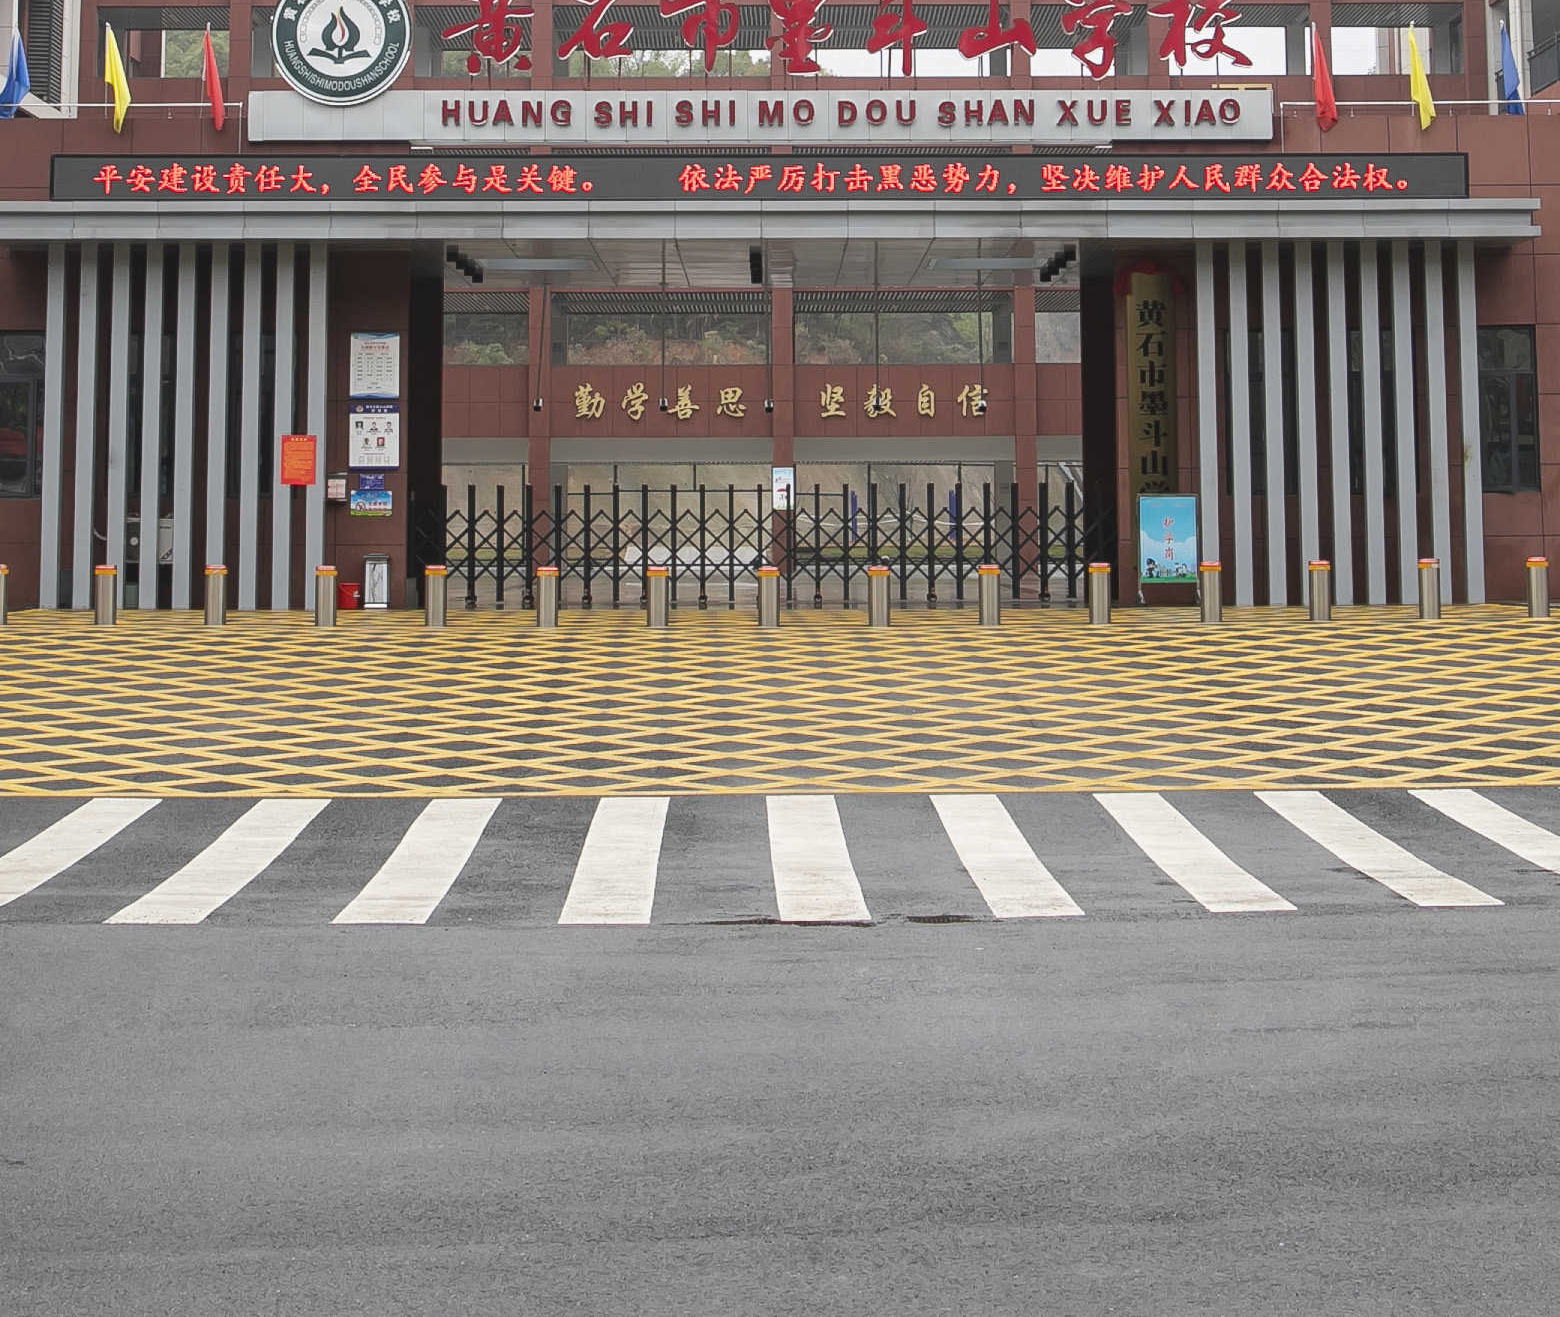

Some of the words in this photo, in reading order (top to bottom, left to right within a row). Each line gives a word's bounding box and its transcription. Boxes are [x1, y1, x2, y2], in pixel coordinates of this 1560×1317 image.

[441, 99, 571, 126] HUANG
[594, 100, 653, 126] SHI
[675, 99, 736, 126] SHI
[758, 99, 815, 125] MO
[838, 99, 917, 125] DOU
[937, 98, 1035, 125] SHAN
[1057, 98, 1132, 125] XUE
[1153, 98, 1241, 125] XIAO
[92, 163, 595, 196] 平安建设责任大，全民参与是关键。
[678, 162, 1409, 195] 依法严厉打击黑恶势力，坚决维护人民群众合法权。
[574, 383, 746, 420] 勤学善思
[818, 383, 990, 418] 坚毅自信
